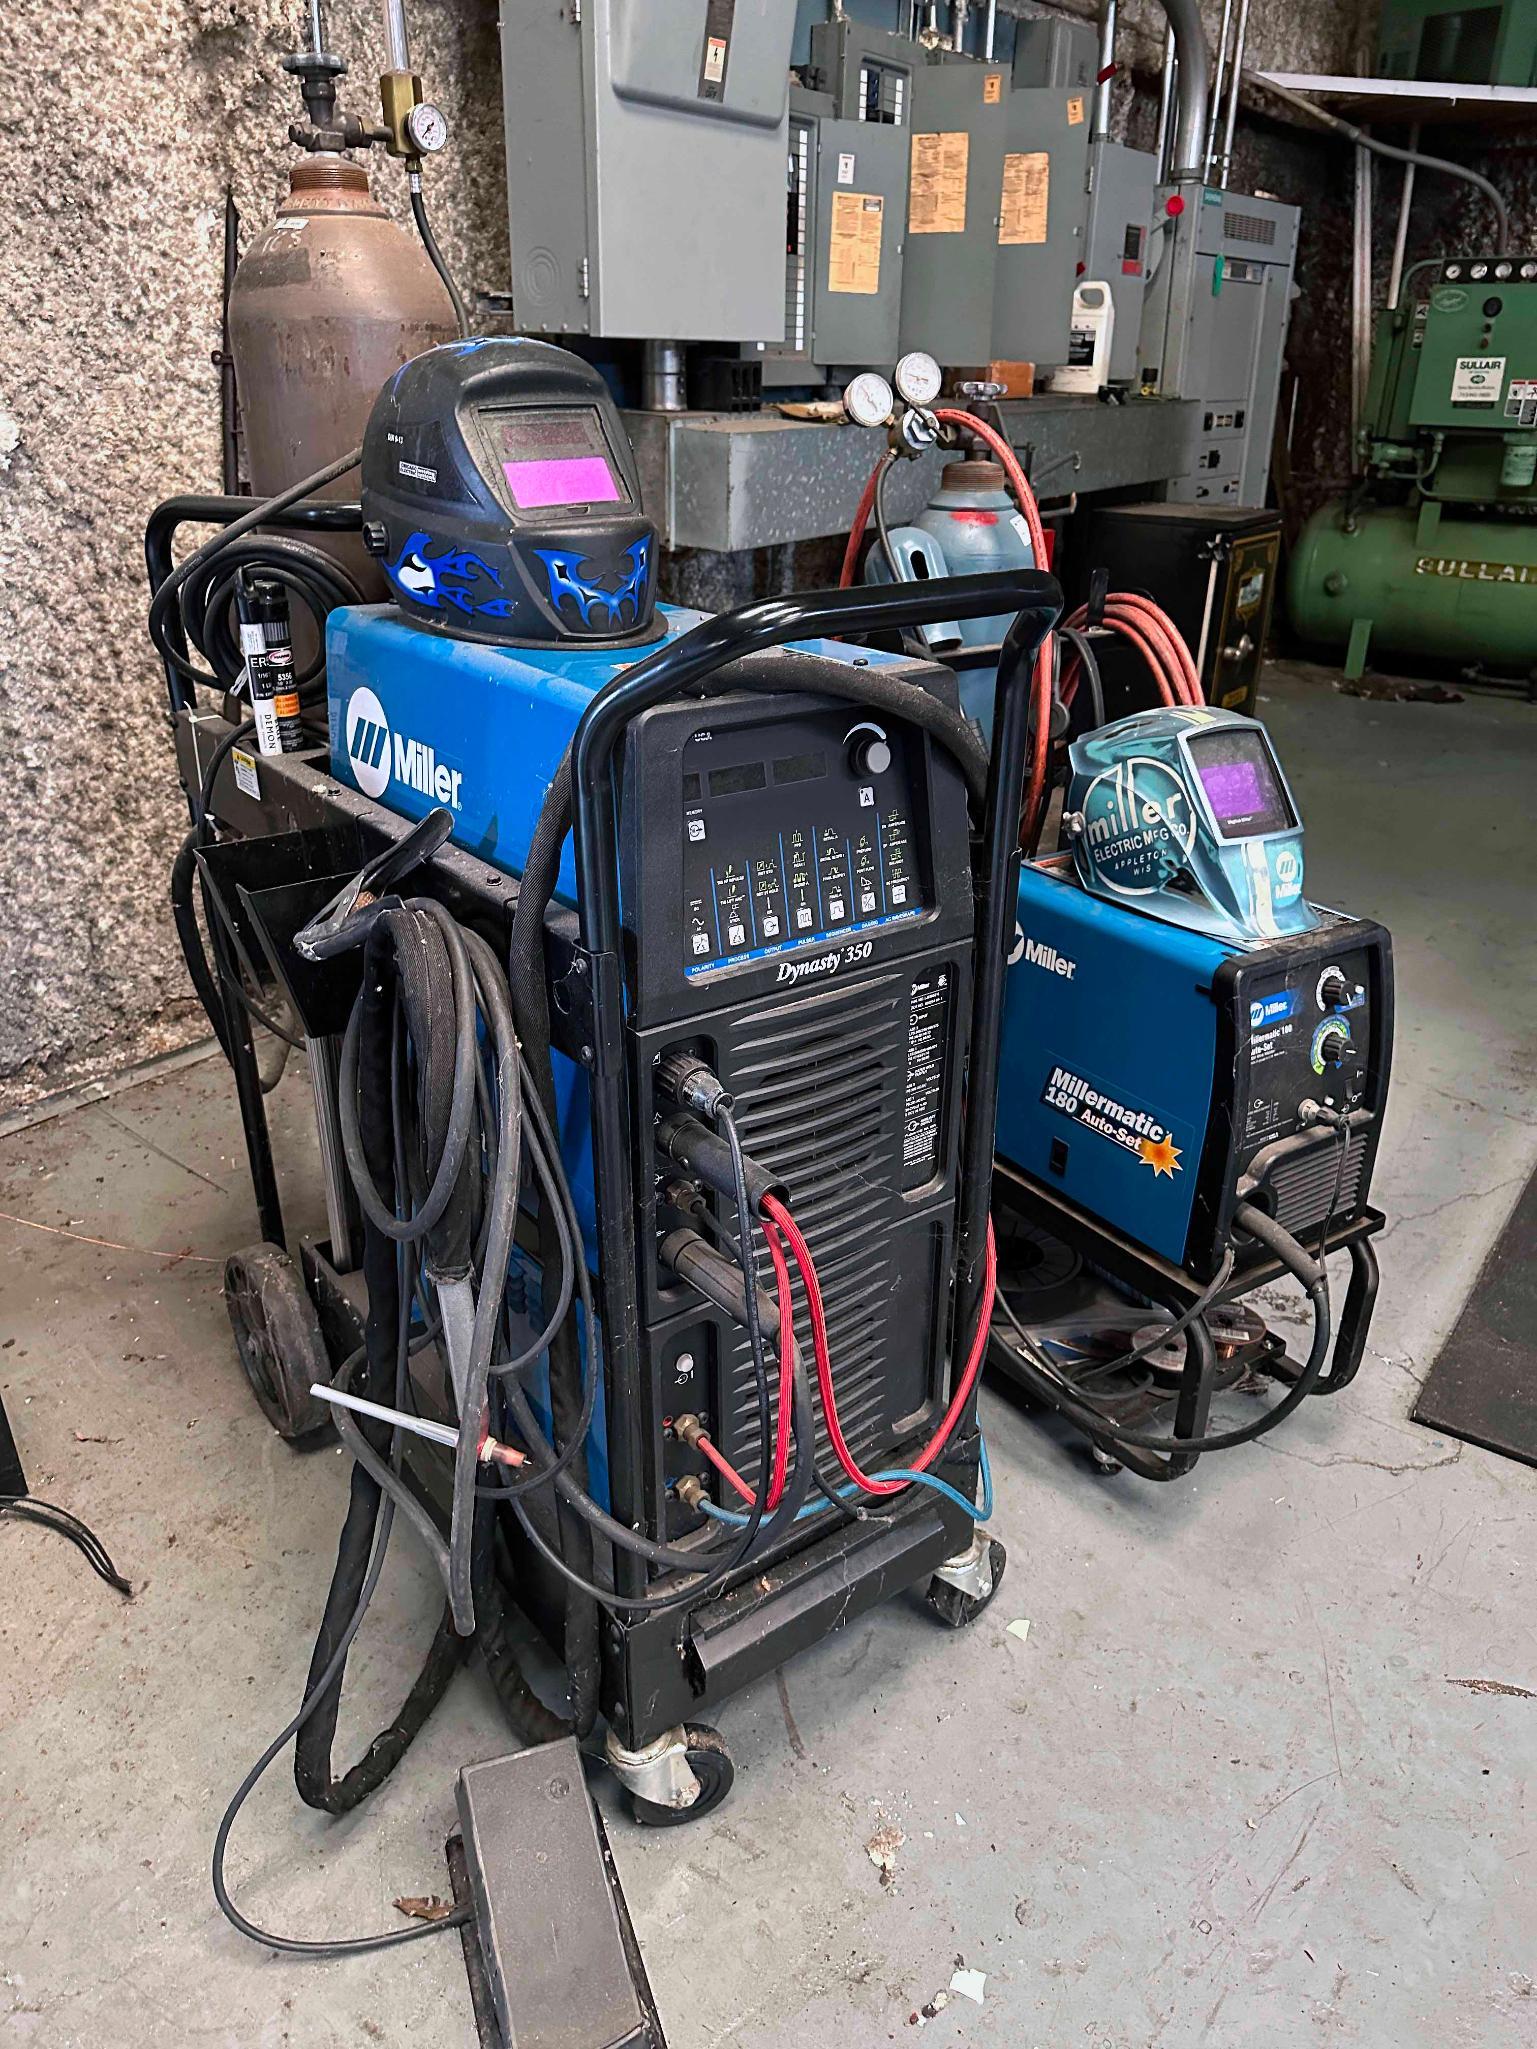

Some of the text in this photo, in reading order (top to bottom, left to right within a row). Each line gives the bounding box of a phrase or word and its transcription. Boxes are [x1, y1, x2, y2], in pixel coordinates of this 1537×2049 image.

[1460, 361, 1501, 370] SULLAIR
[265, 713, 277, 749] DEMON
[394, 732, 463, 809] Miller
[1087, 759, 1182, 845] miller
[1094, 834, 1142, 863] ELECTRIC
[1115, 850, 1168, 870] APPLETON
[691, 963, 716, 974] POLARITY
[776, 941, 873, 985] Dynasty 350
[1025, 938, 1076, 980] Miller
[1045, 1086, 1143, 1150] 180 Auto-Set
[1050, 1067, 1164, 1141] Millermatic
